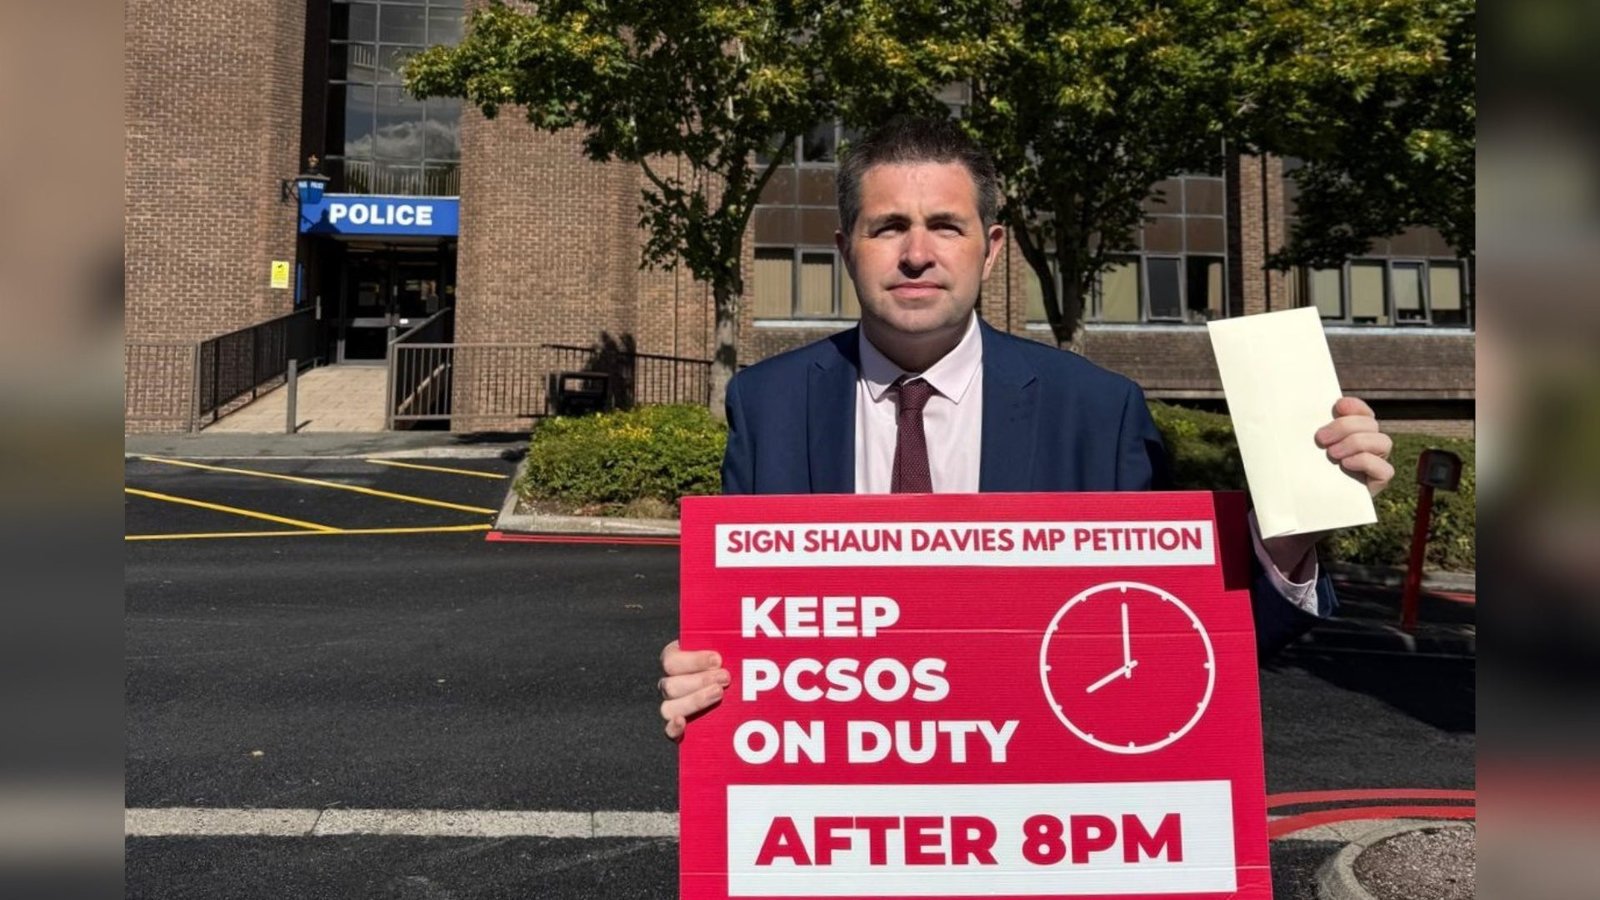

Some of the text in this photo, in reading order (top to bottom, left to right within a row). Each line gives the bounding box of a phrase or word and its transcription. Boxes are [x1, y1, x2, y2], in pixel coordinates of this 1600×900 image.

[329, 204, 432, 226] POLICE
[727, 527, 1203, 554] SIGN SHAUN DAVIES MP PETITION
[741, 597, 900, 638] KEEP
[741, 658, 950, 703] PCSOS
[733, 720, 1019, 764] ON DUTY
[755, 813, 1184, 865] AFTER 8PM
